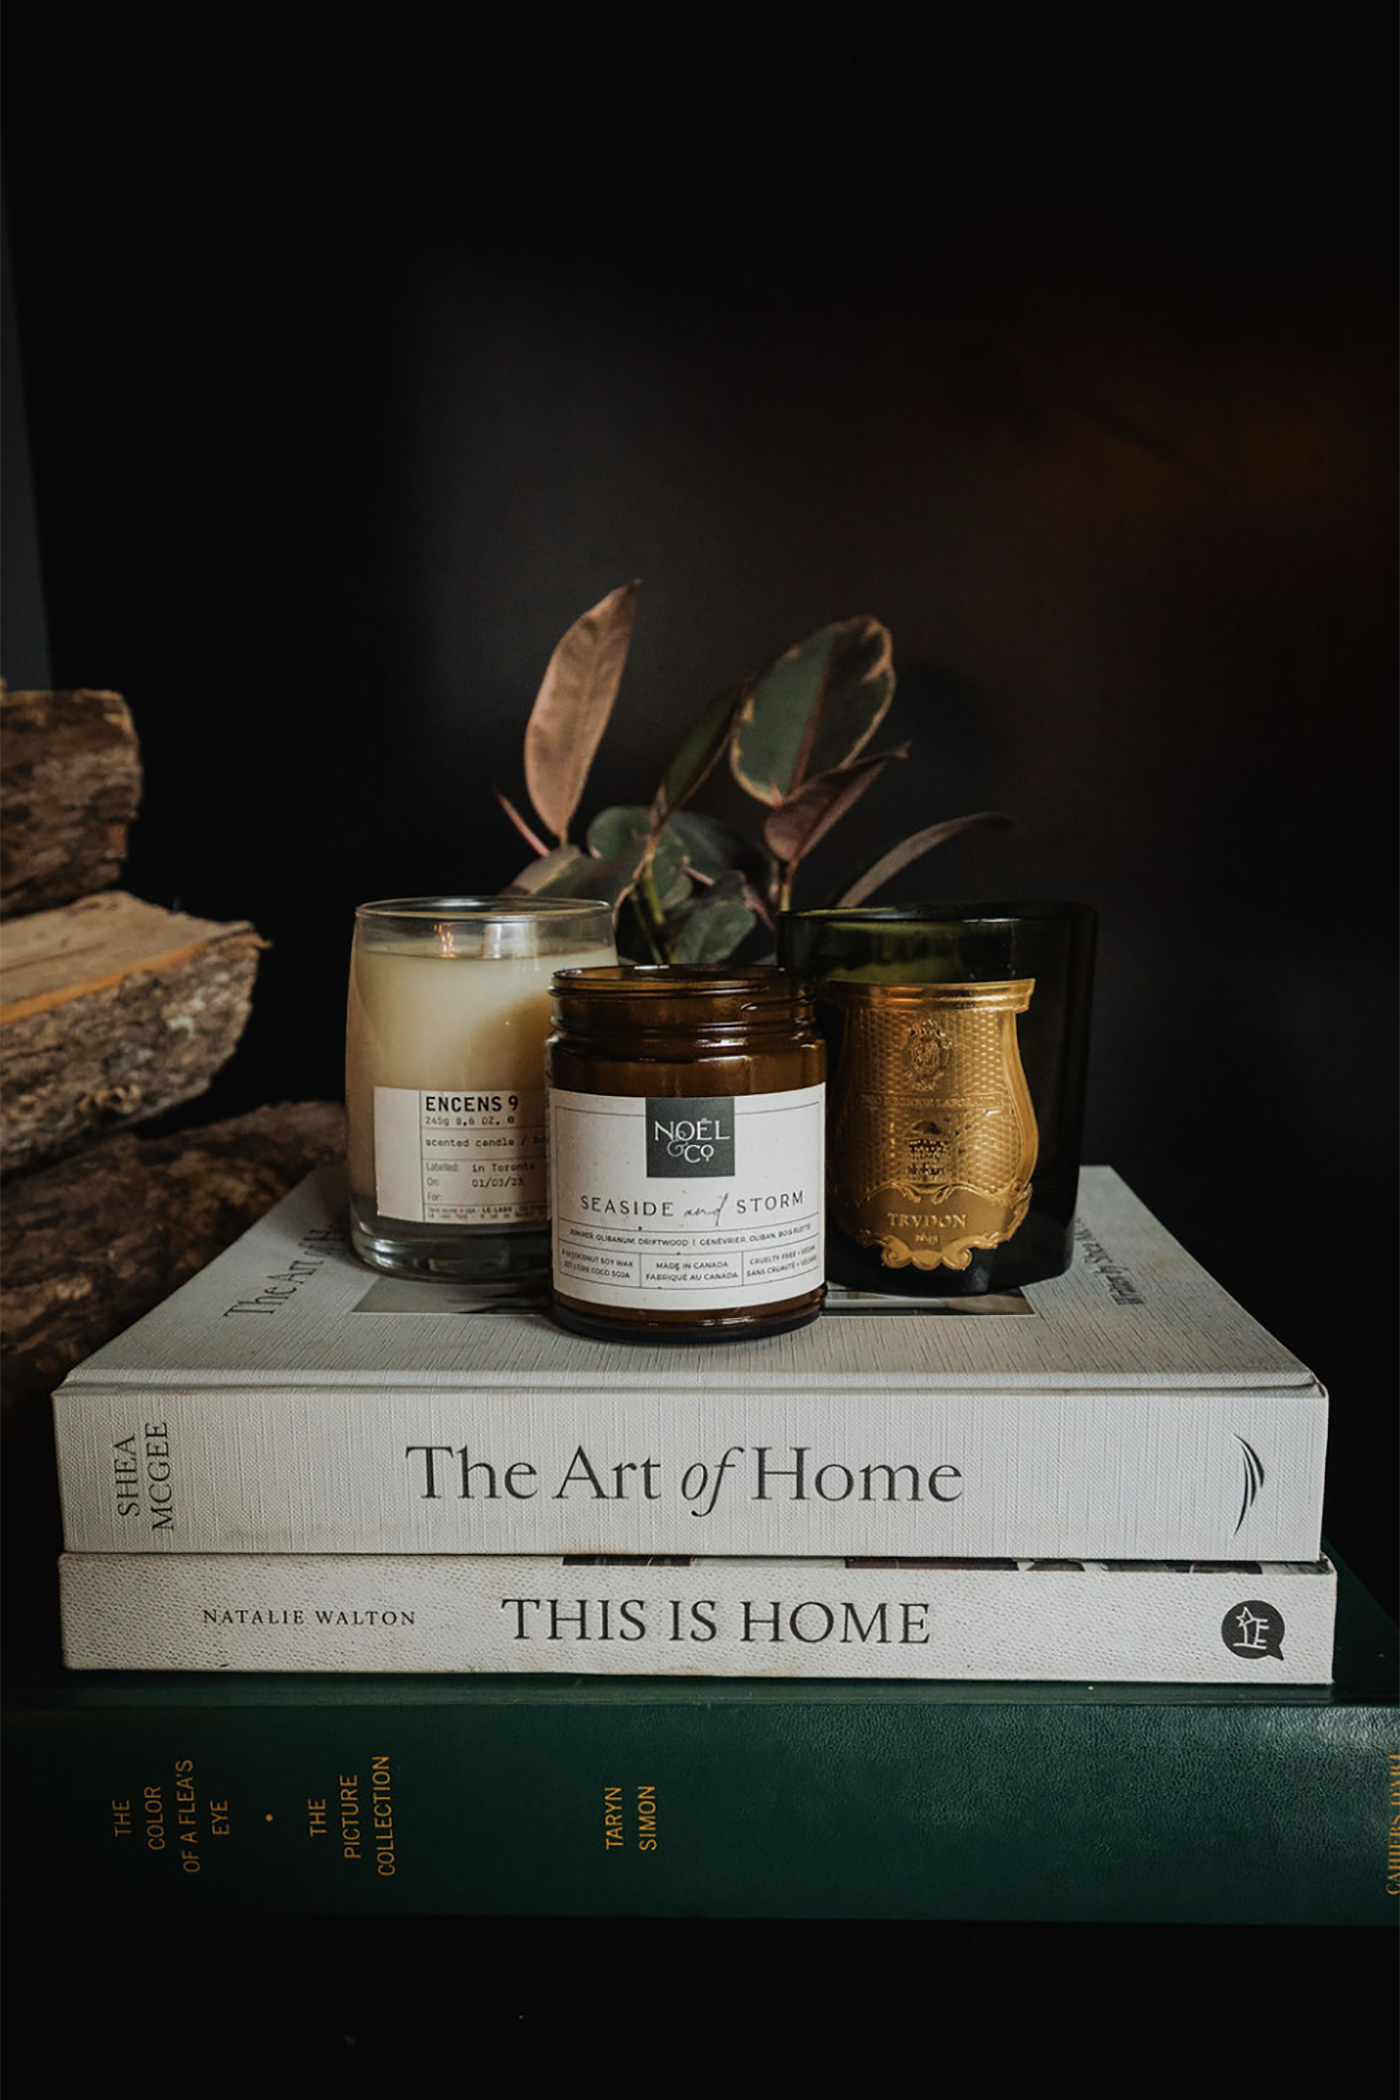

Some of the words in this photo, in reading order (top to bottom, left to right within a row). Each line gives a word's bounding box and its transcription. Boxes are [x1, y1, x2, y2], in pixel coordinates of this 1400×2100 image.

[425, 1096, 502, 1112] ENCENS
[508, 1095, 519, 1111] 9
[425, 1116, 450, 1126] 245g
[425, 1137, 470, 1148] scented
[475, 1136, 515, 1147] candle
[472, 1163, 485, 1172] in
[492, 1161, 535, 1172] Toronto
[580, 1194, 675, 1218] SEASIDE
[683, 1193, 729, 1227] and
[736, 1189, 805, 1215] STORM
[638, 1238, 689, 1247] DRIFTWOOD
[781, 1250, 797, 1261] FREE
[591, 1267, 609, 1277] COCO
[611, 1270, 631, 1279] SOJA
[600, 1257, 615, 1266] SOY
[616, 1259, 634, 1268] WAX
[645, 1271, 688, 1282] FABRIQUÉ
[689, 1273, 702, 1281] AU
[703, 1271, 739, 1281] CANADA
[656, 1262, 680, 1271] MADE
[682, 1262, 692, 1270] IN
[693, 1261, 730, 1270] CANADA
[746, 1268, 766, 1278] SANS
[113, 1435, 140, 1517] SHEA
[144, 1422, 175, 1531] MCGEE
[405, 1446, 538, 1501] The
[556, 1445, 662, 1501] Art
[681, 1446, 745, 1518] of
[755, 1447, 963, 1503] Home
[203, 1609, 304, 1626] NATALIE
[316, 1610, 416, 1627] WALTON
[501, 1598, 646, 1641] THIS
[669, 1600, 718, 1642] IS
[740, 1601, 930, 1644] HOME
[175, 1758, 196, 1825] FLEA'S
[112, 1798, 132, 1838] THE
[143, 1786, 166, 1850] COLOR
[209, 1798, 230, 1836] EYE
[307, 1798, 328, 1838] THE
[339, 1774, 362, 1860] PICTURE
[371, 1755, 397, 1877] COLLECTION
[604, 1786, 624, 1851] TARYN
[637, 1785, 658, 1852] SIMON
[179, 1831, 199, 1844] A
[181, 1849, 201, 1874] OF
